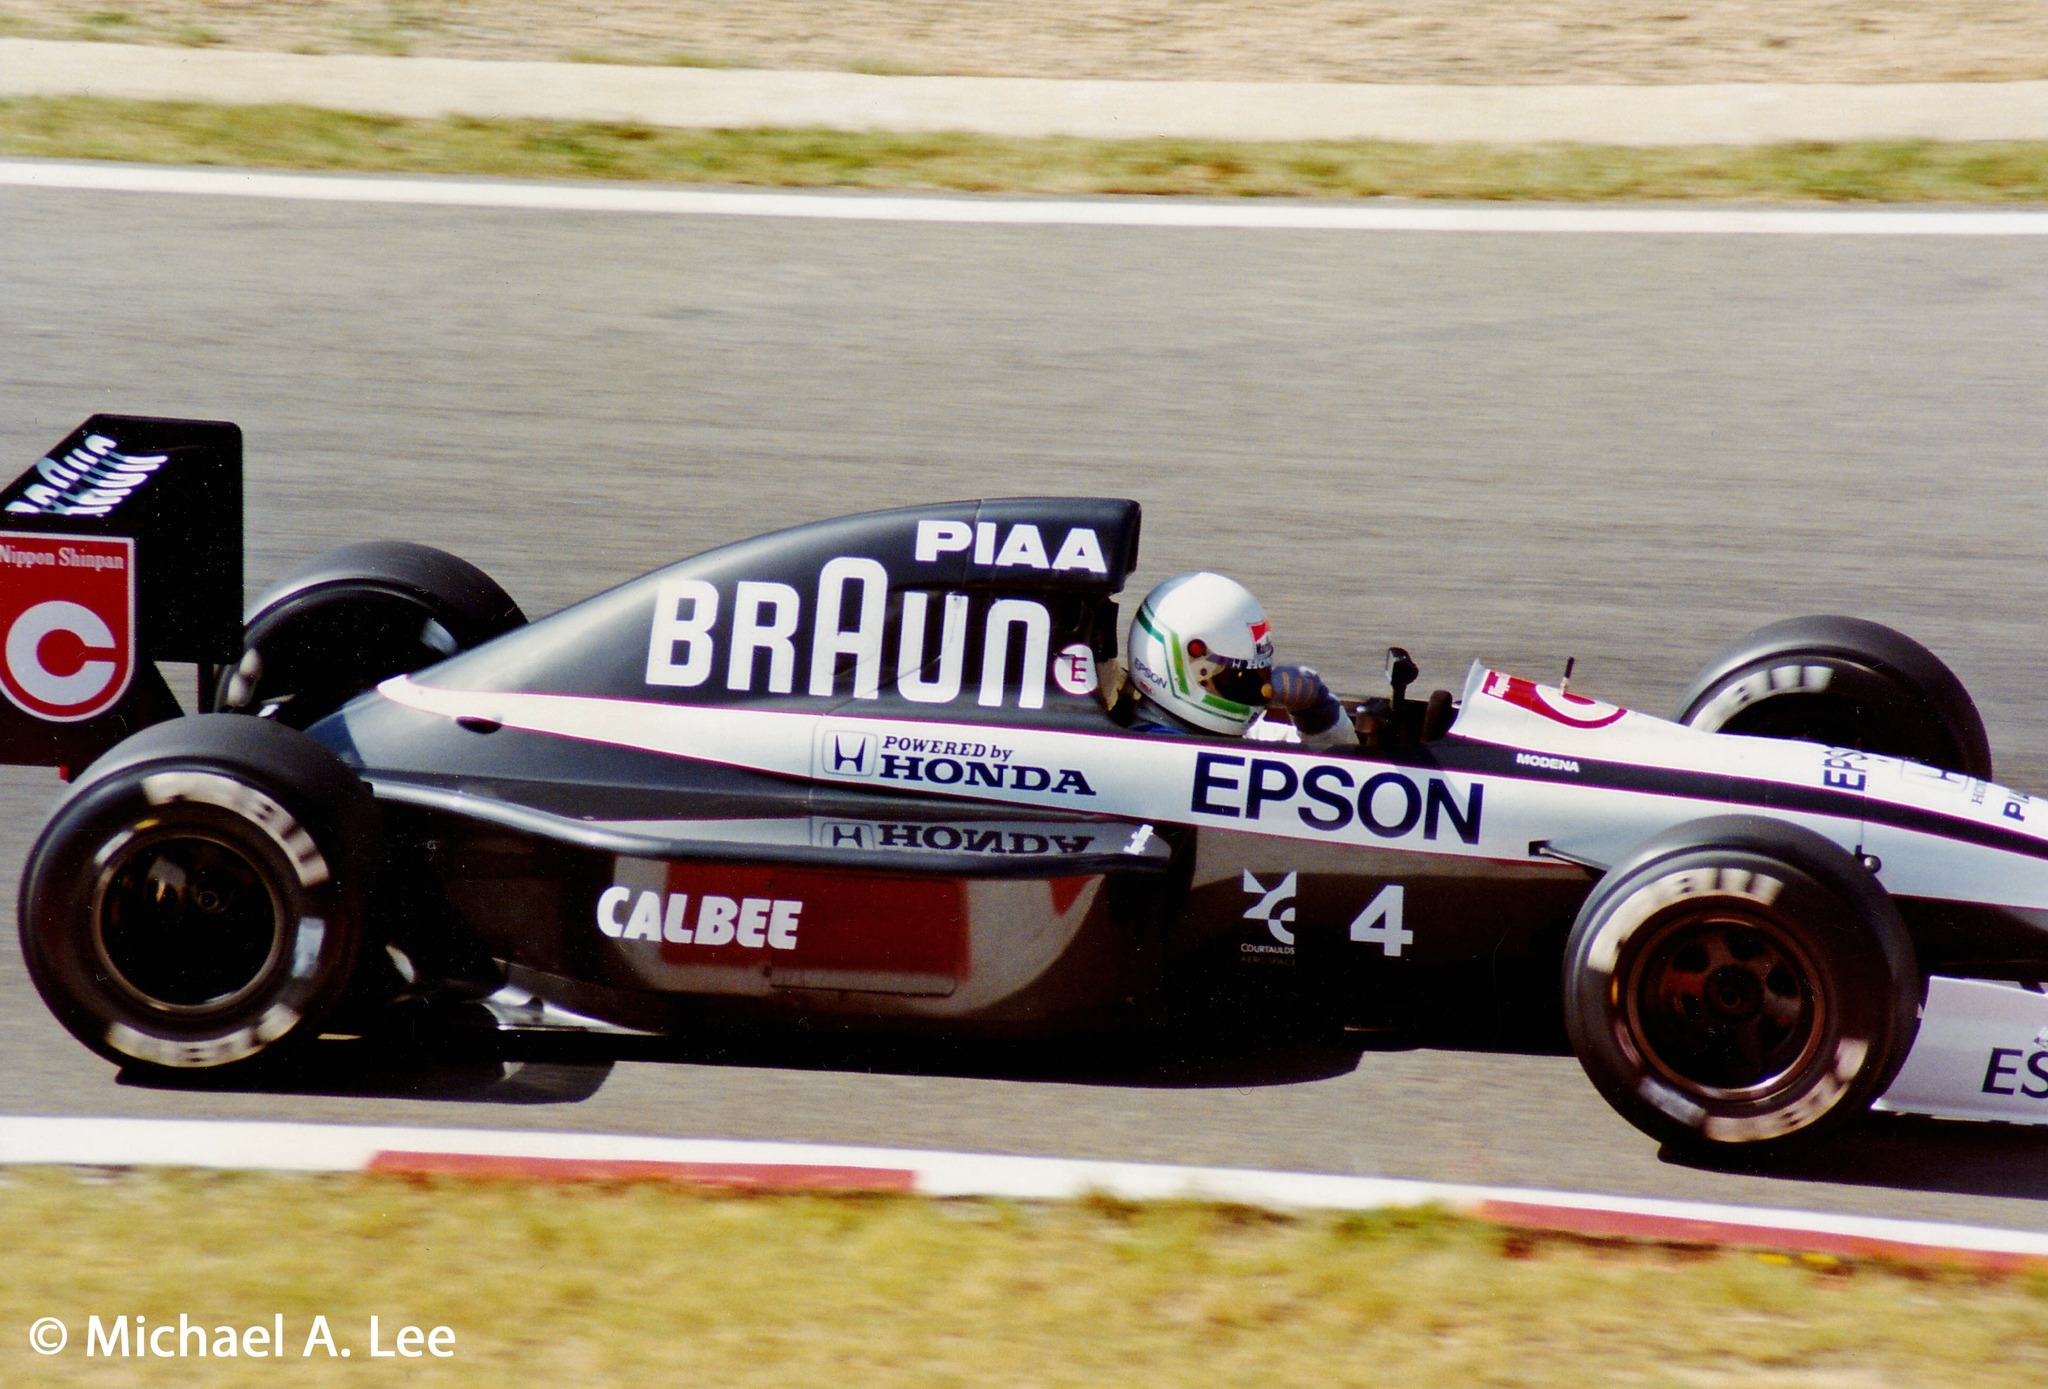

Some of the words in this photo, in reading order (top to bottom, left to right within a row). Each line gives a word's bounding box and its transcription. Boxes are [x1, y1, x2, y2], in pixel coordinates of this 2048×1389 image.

[0, 544, 55, 568] Nippon
[58, 547, 124, 572] Shinpan
[914, 519, 1108, 573] PIAA
[644, 555, 1051, 709] BRAUN
[1071, 656, 1088, 683] E
[1133, 657, 1168, 689] EPSON
[883, 735, 987, 758] POWERED
[990, 744, 1015, 762] by
[1516, 752, 1580, 773] MODENA
[879, 753, 1097, 796] HONDA
[1191, 751, 1485, 846] EPSON
[596, 885, 803, 951] CALBEE
[1349, 884, 1414, 957] 4
